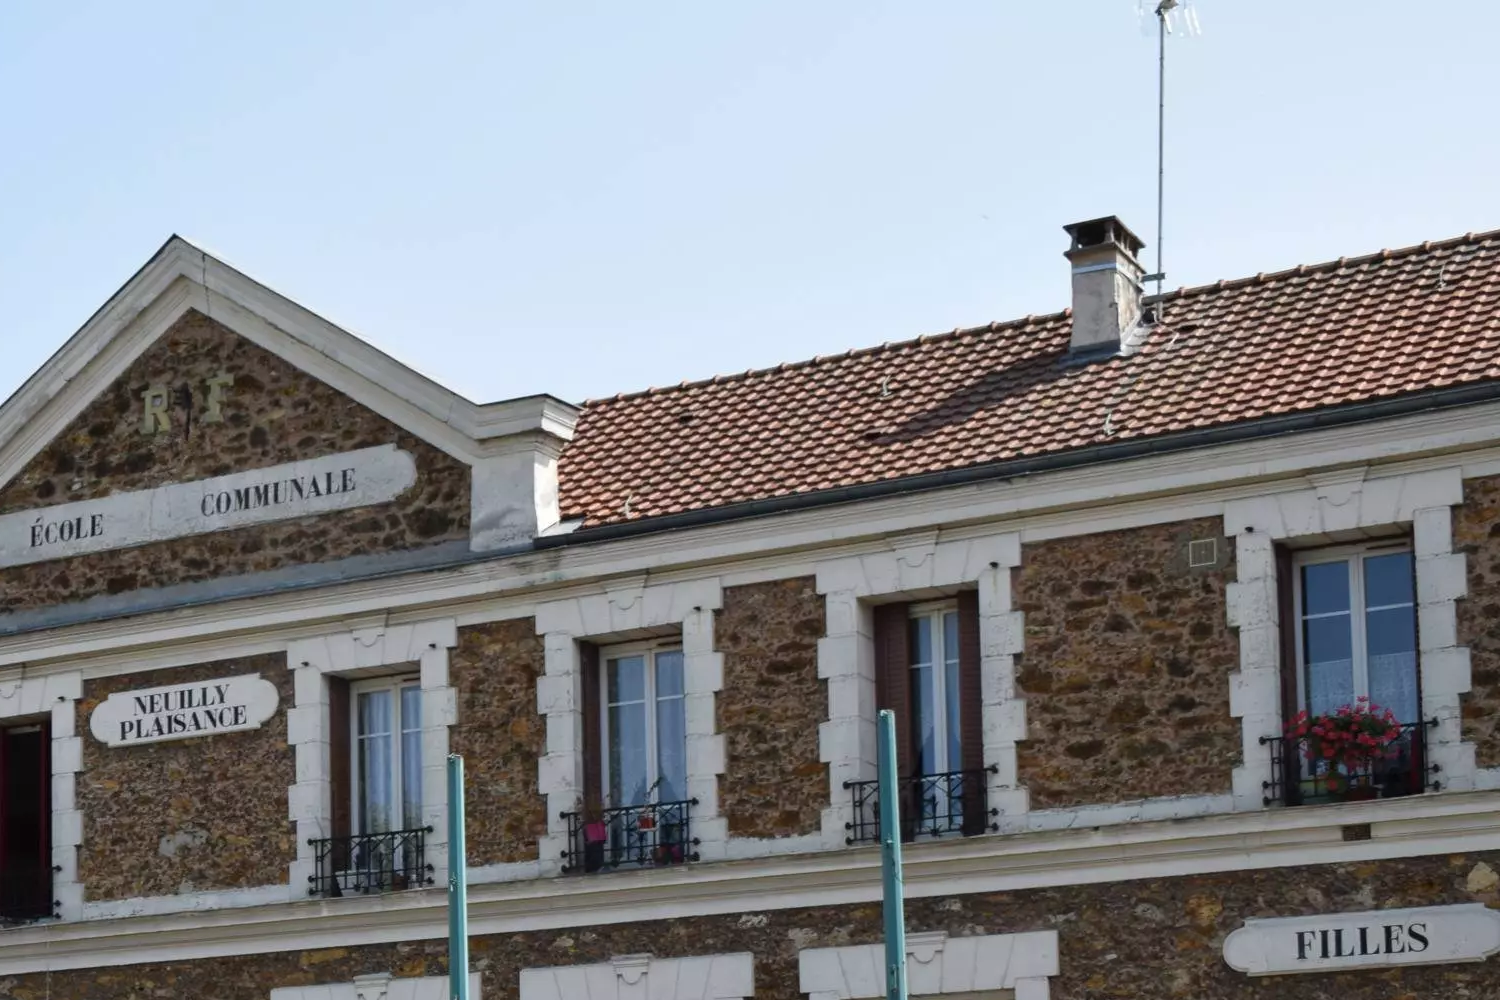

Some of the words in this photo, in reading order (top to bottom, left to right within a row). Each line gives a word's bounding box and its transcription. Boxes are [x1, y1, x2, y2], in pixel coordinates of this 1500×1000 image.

[30, 514, 103, 548] ÉCOLE
[200, 468, 356, 517] COMMUNALE
[133, 684, 230, 716] NEUILLY
[120, 705, 247, 741] PLAISANCE
[1295, 922, 1429, 960] FILLES
